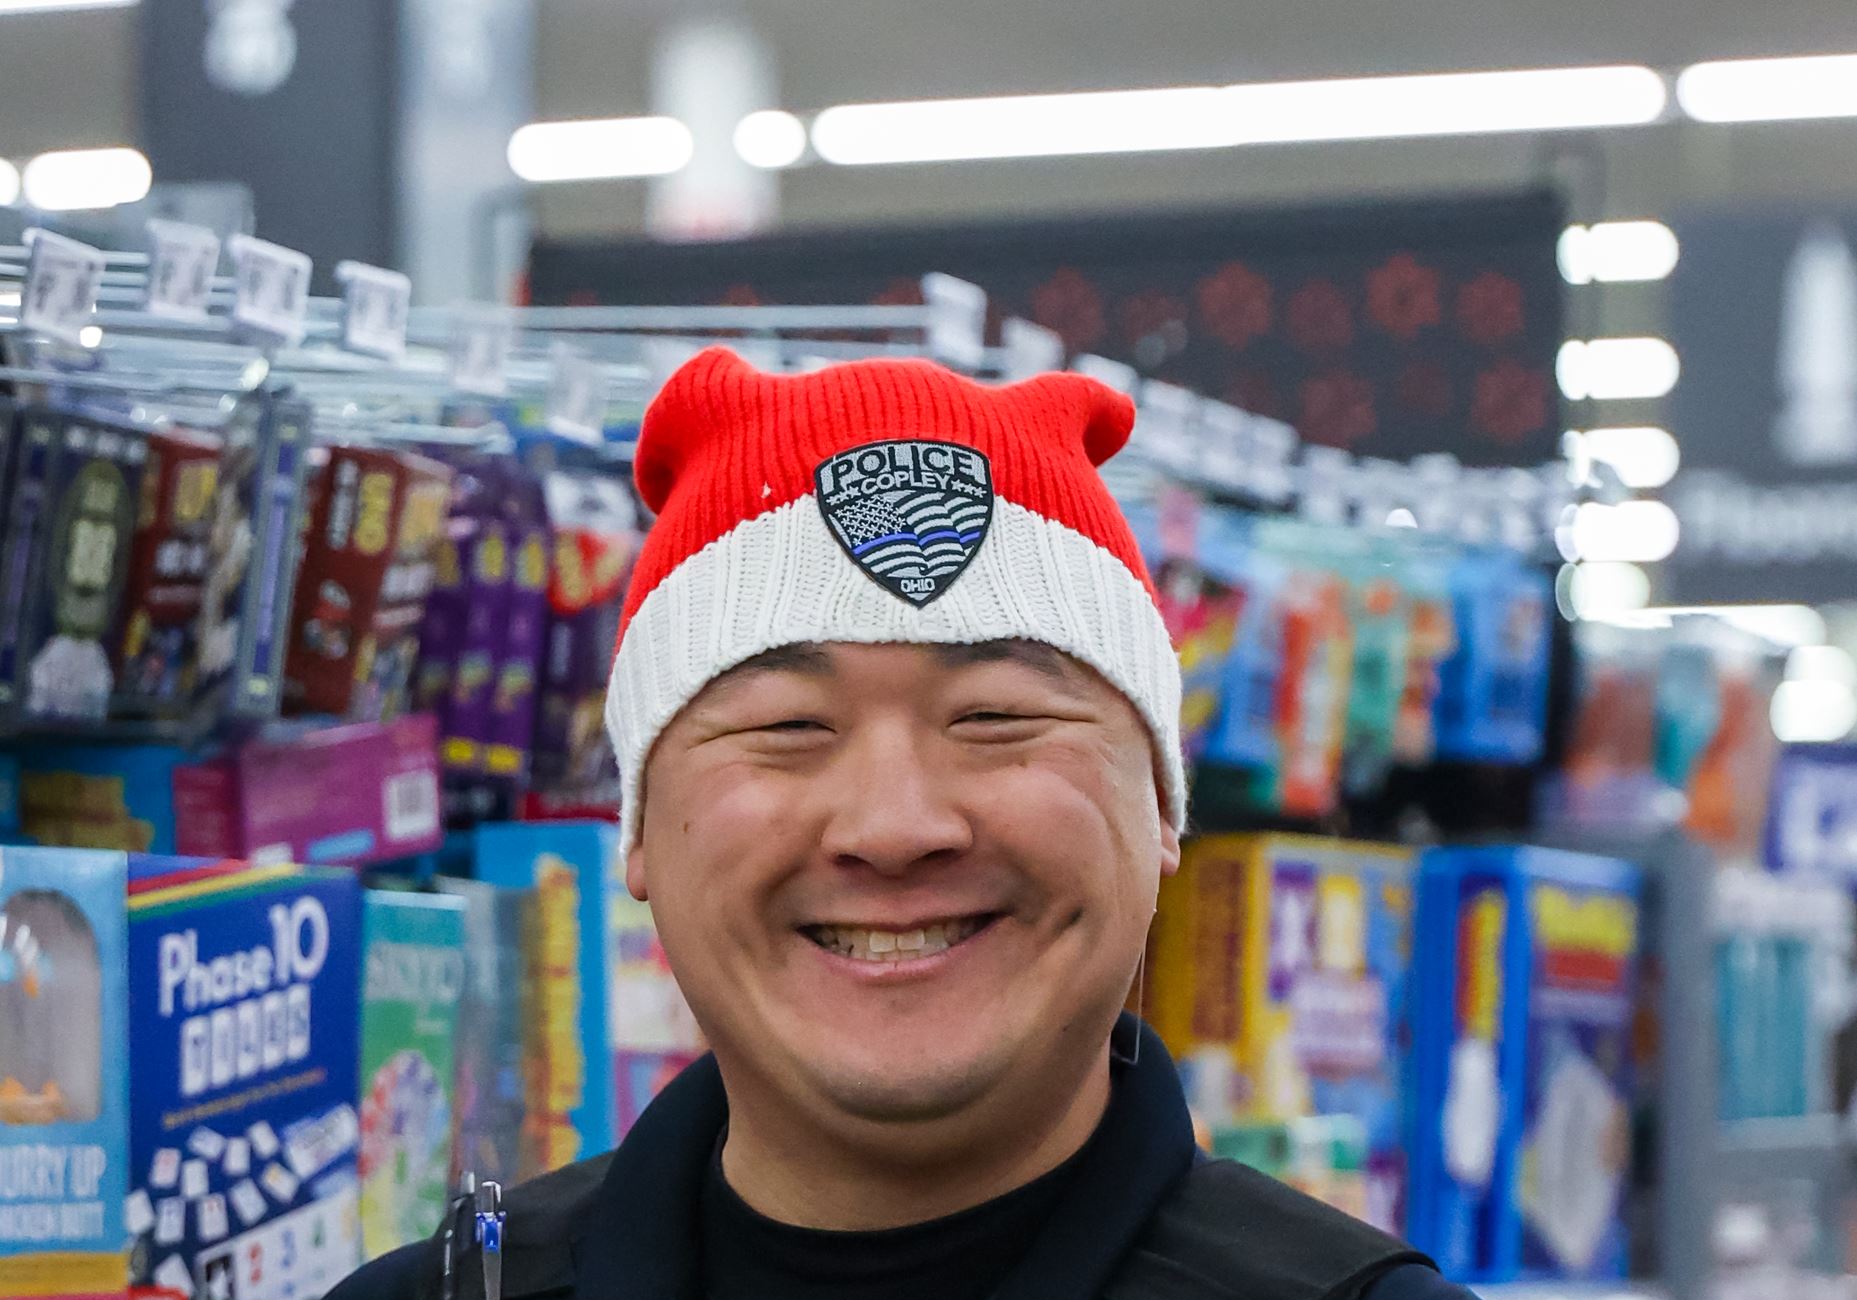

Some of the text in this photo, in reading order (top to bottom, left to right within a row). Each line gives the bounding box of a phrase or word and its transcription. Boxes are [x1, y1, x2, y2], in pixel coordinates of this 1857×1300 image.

[831, 444, 974, 495] POLICE
[860, 470, 952, 495] COPLEY
[900, 577, 936, 593] OHIO
[159, 895, 330, 1018] Phase 10
